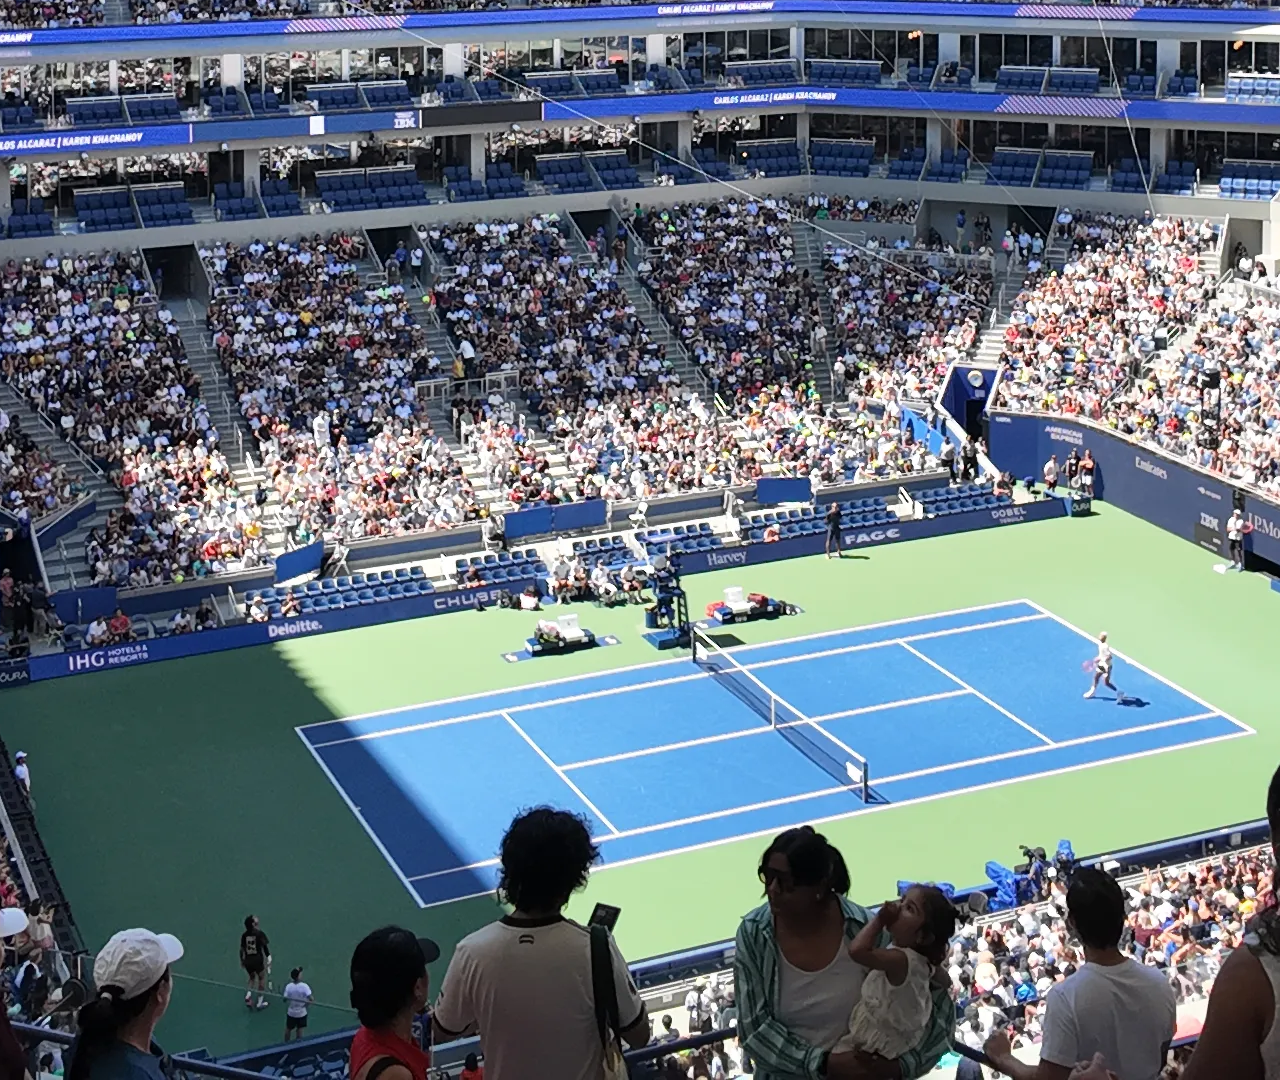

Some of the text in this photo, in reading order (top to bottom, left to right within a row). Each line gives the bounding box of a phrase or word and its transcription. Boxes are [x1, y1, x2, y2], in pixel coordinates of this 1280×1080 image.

[394, 118, 416, 128] IBM
[17, 138, 56, 149] ALCARAZ
[62, 135, 91, 146] KAREN
[991, 506, 1027, 519] DOBEL
[706, 550, 747, 566] Harvey
[268, 619, 323, 638] Deloitte.
[108, 645, 141, 657] HOTELS
[108, 651, 149, 664] RESORTS
[69, 651, 105, 671] IHG
